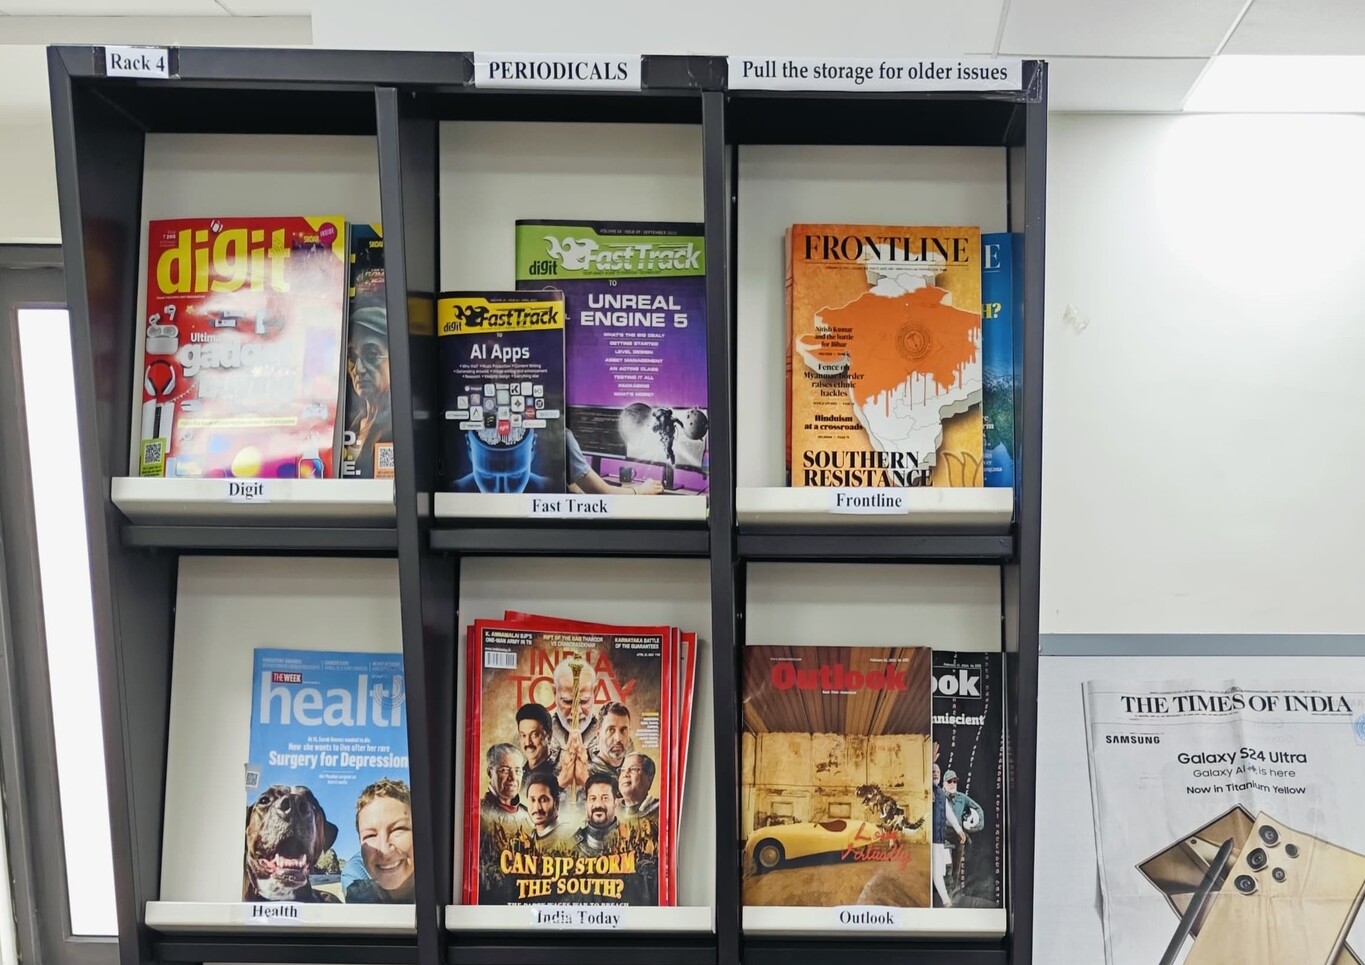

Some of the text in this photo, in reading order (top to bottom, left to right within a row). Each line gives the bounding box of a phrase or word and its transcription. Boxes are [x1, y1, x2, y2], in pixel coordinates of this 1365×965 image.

[111, 53, 165, 72] Rack 4
[489, 61, 628, 80] PERIODICALS
[742, 61, 1008, 84] Pull the storage for older issues
[804, 235, 969, 264] FRONTLINE
[156, 229, 290, 294] digit
[589, 294, 681, 310] UNREAL
[581, 313, 688, 327] ENGINE 5
[471, 344, 530, 362] AI Apps
[803, 450, 920, 469] SOUTHERN
[804, 469, 934, 487] RESISTANCE
[229, 482, 264, 499] Digit
[532, 499, 608, 513] Fast Track
[837, 493, 902, 508] Frontline
[770, 662, 908, 692] Outlook
[1121, 693, 1352, 714] THE TIMES OF INDIA
[1106, 734, 1160, 744] SAMSUNG
[269, 751, 408, 769] Surgery for Depression
[1178, 748, 1307, 765] Galaxy S24 Ultra
[1226, 780, 1306, 794] Titanium Yellow
[500, 851, 637, 883] CAN BJP STORM
[516, 877, 624, 899] THE SOUTH?
[252, 904, 298, 918] Health
[537, 910, 621, 928] India Today
[840, 910, 894, 925] Outlook
